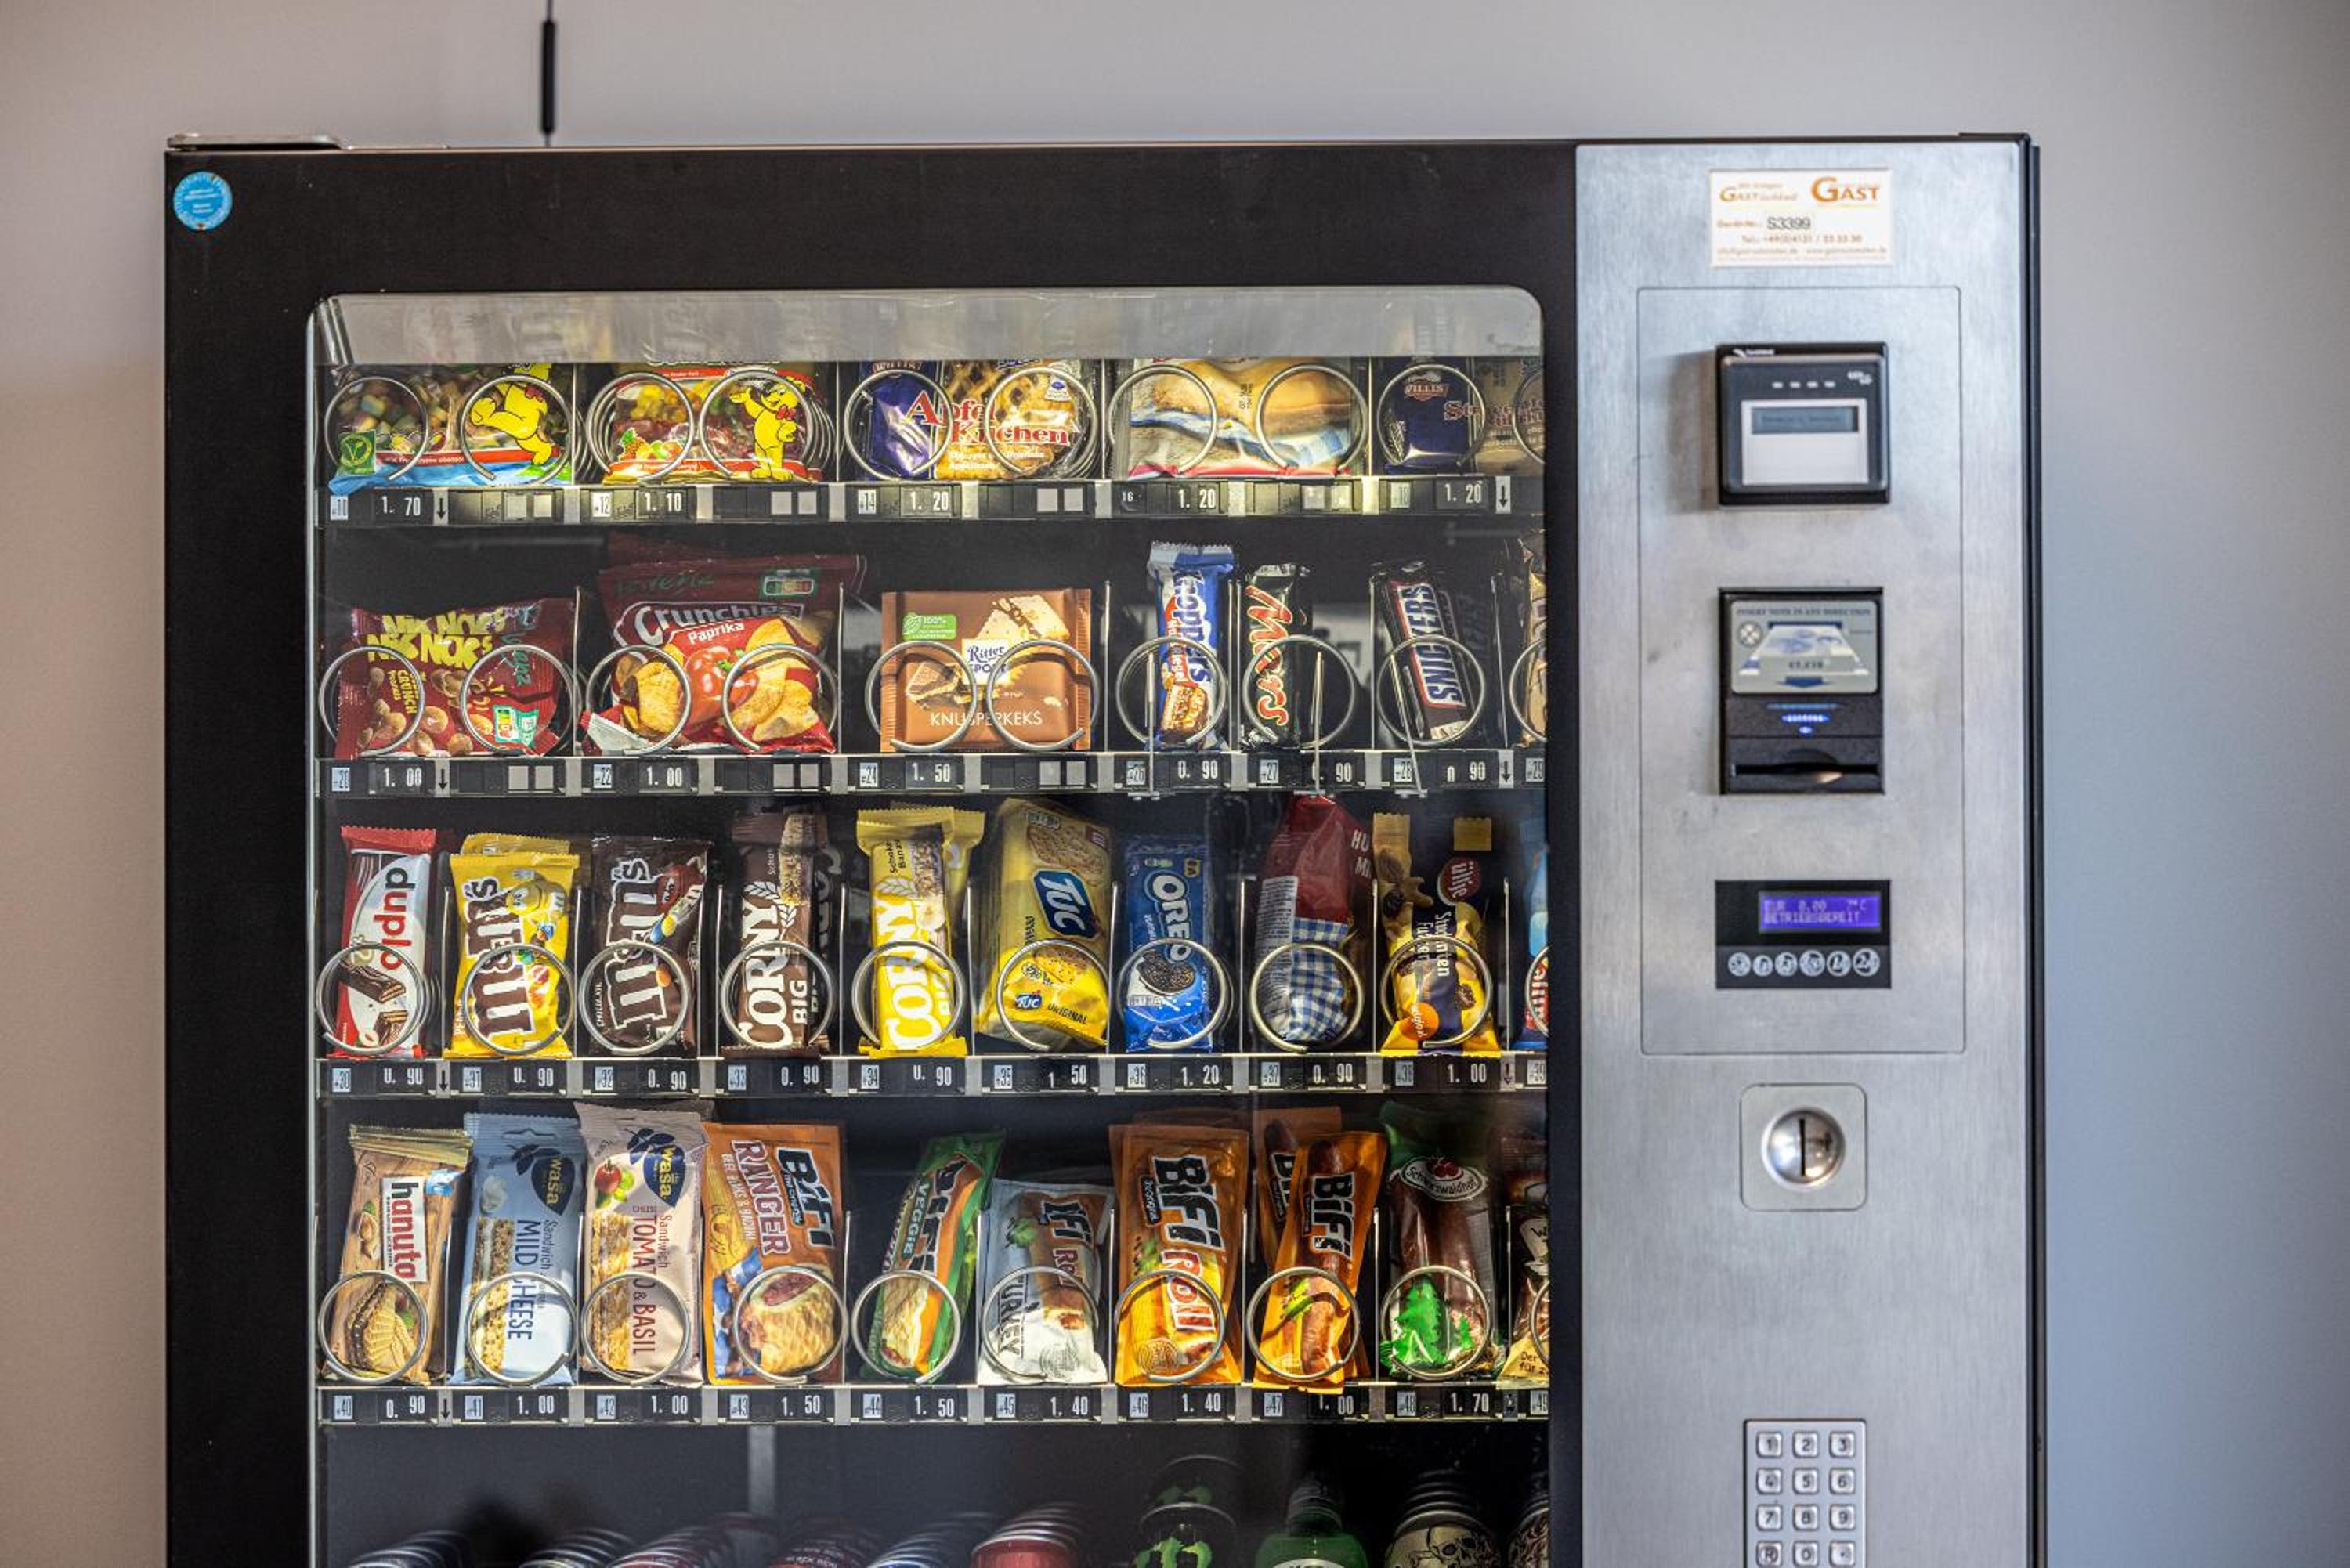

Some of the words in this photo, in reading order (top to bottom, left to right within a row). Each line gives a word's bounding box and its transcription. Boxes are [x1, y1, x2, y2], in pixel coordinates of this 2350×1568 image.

[1811, 176, 1878, 202] GAST
[1767, 217, 1811, 230] S3399
[688, 623, 745, 645] Paprika
[967, 645, 1006, 663] Ritter
[374, 868, 415, 970] duplo
[1152, 874, 1192, 962] OREO
[789, 979, 808, 1025] BIG
[546, 1156, 562, 1205] wasa
[660, 1145, 674, 1198] wasa
[731, 1140, 791, 1256] RANGER
[391, 1181, 423, 1279] hanuto
[515, 1219, 541, 1267] MILD
[540, 1219, 559, 1271] Sandwich
[659, 1214, 672, 1268] Sandwich
[632, 1302, 656, 1355] BASIL
